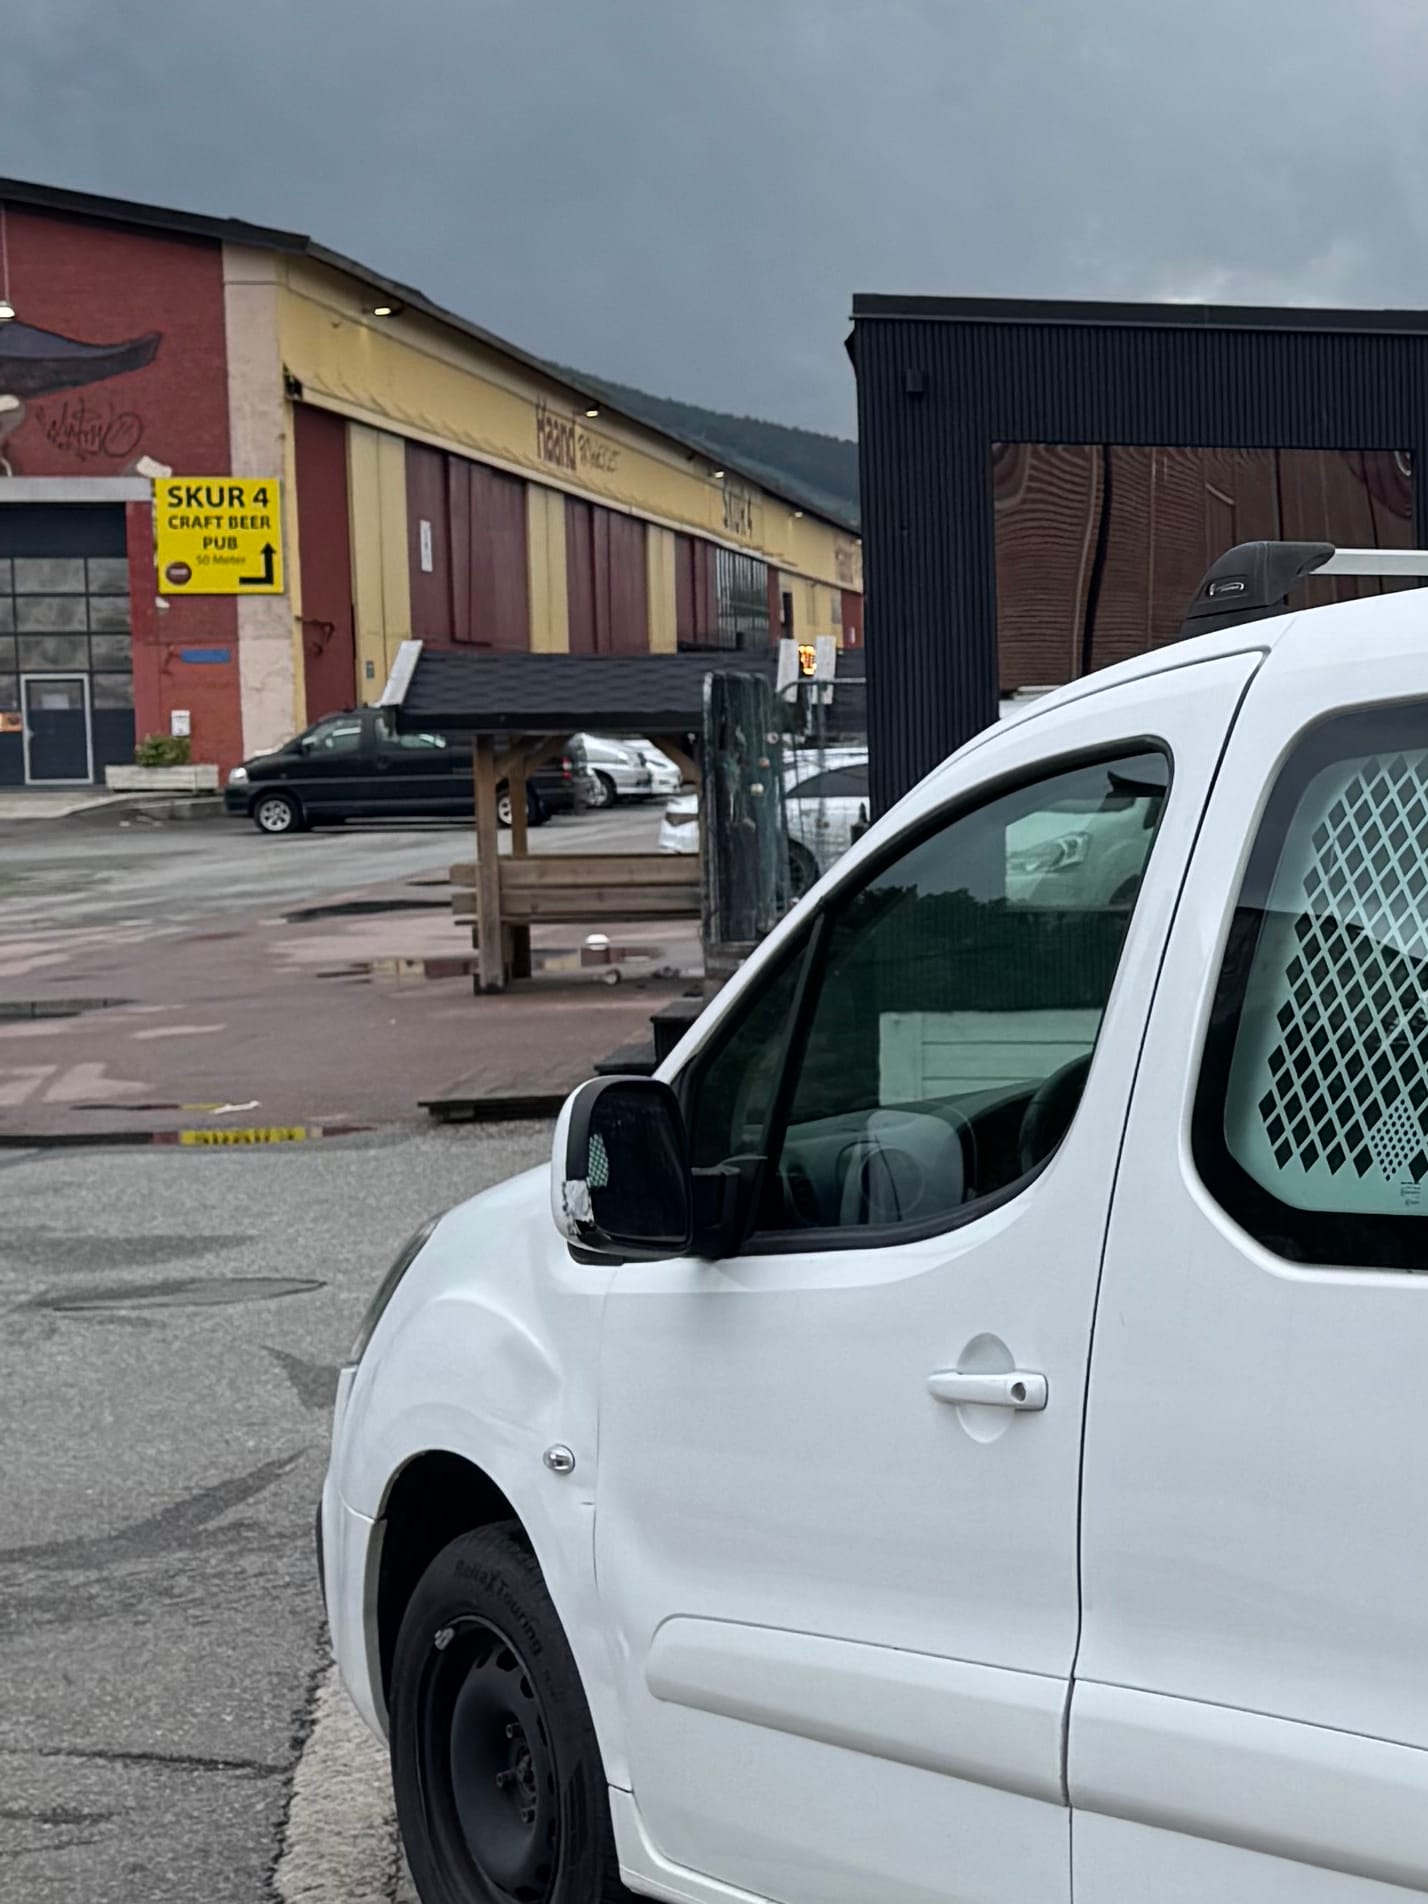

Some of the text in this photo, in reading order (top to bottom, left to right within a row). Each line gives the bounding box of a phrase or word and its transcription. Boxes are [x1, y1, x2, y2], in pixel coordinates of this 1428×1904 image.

[167, 485, 269, 509] SKUR 4
[167, 515, 271, 529] CRAFT BEER
[202, 536, 238, 550] PUB
